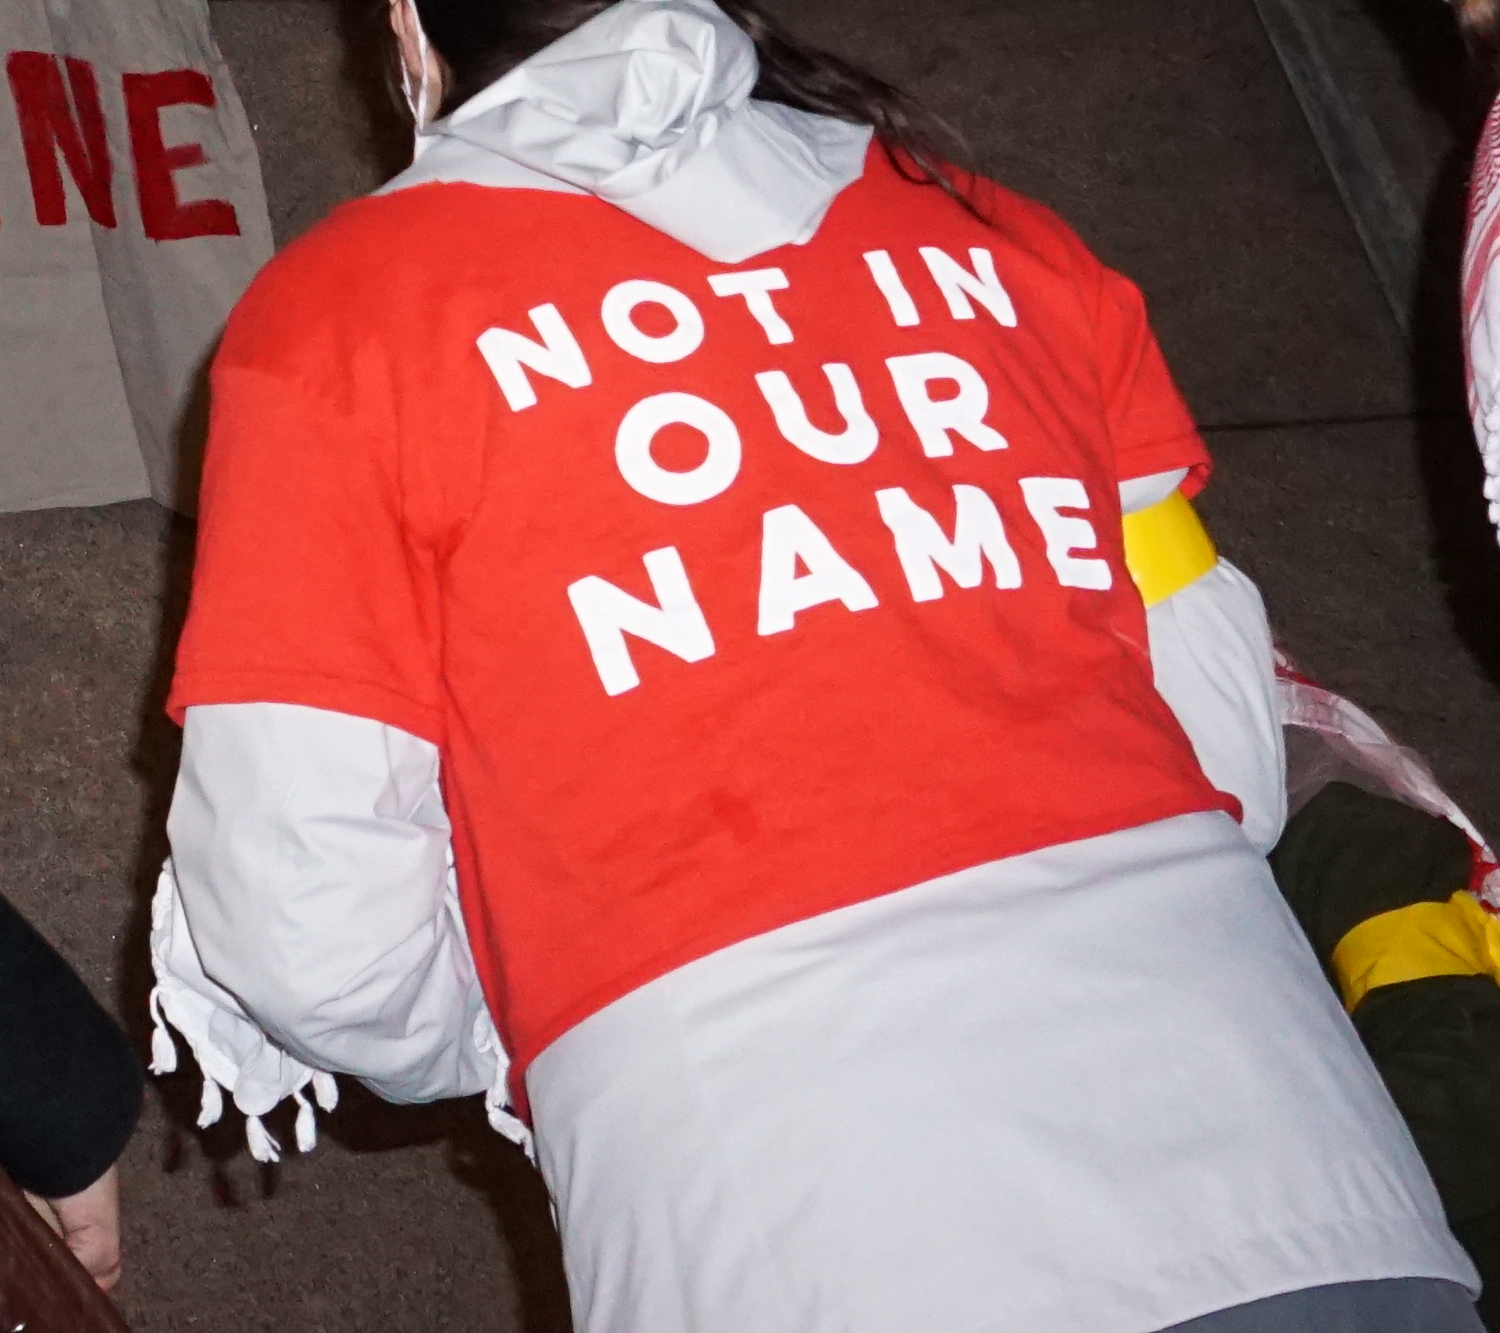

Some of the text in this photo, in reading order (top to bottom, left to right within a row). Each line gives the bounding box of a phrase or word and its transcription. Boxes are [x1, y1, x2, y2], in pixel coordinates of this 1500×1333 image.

[477, 246, 1017, 413] NOT IN
[614, 352, 1008, 506] OUR
[567, 477, 1112, 696] NAME
